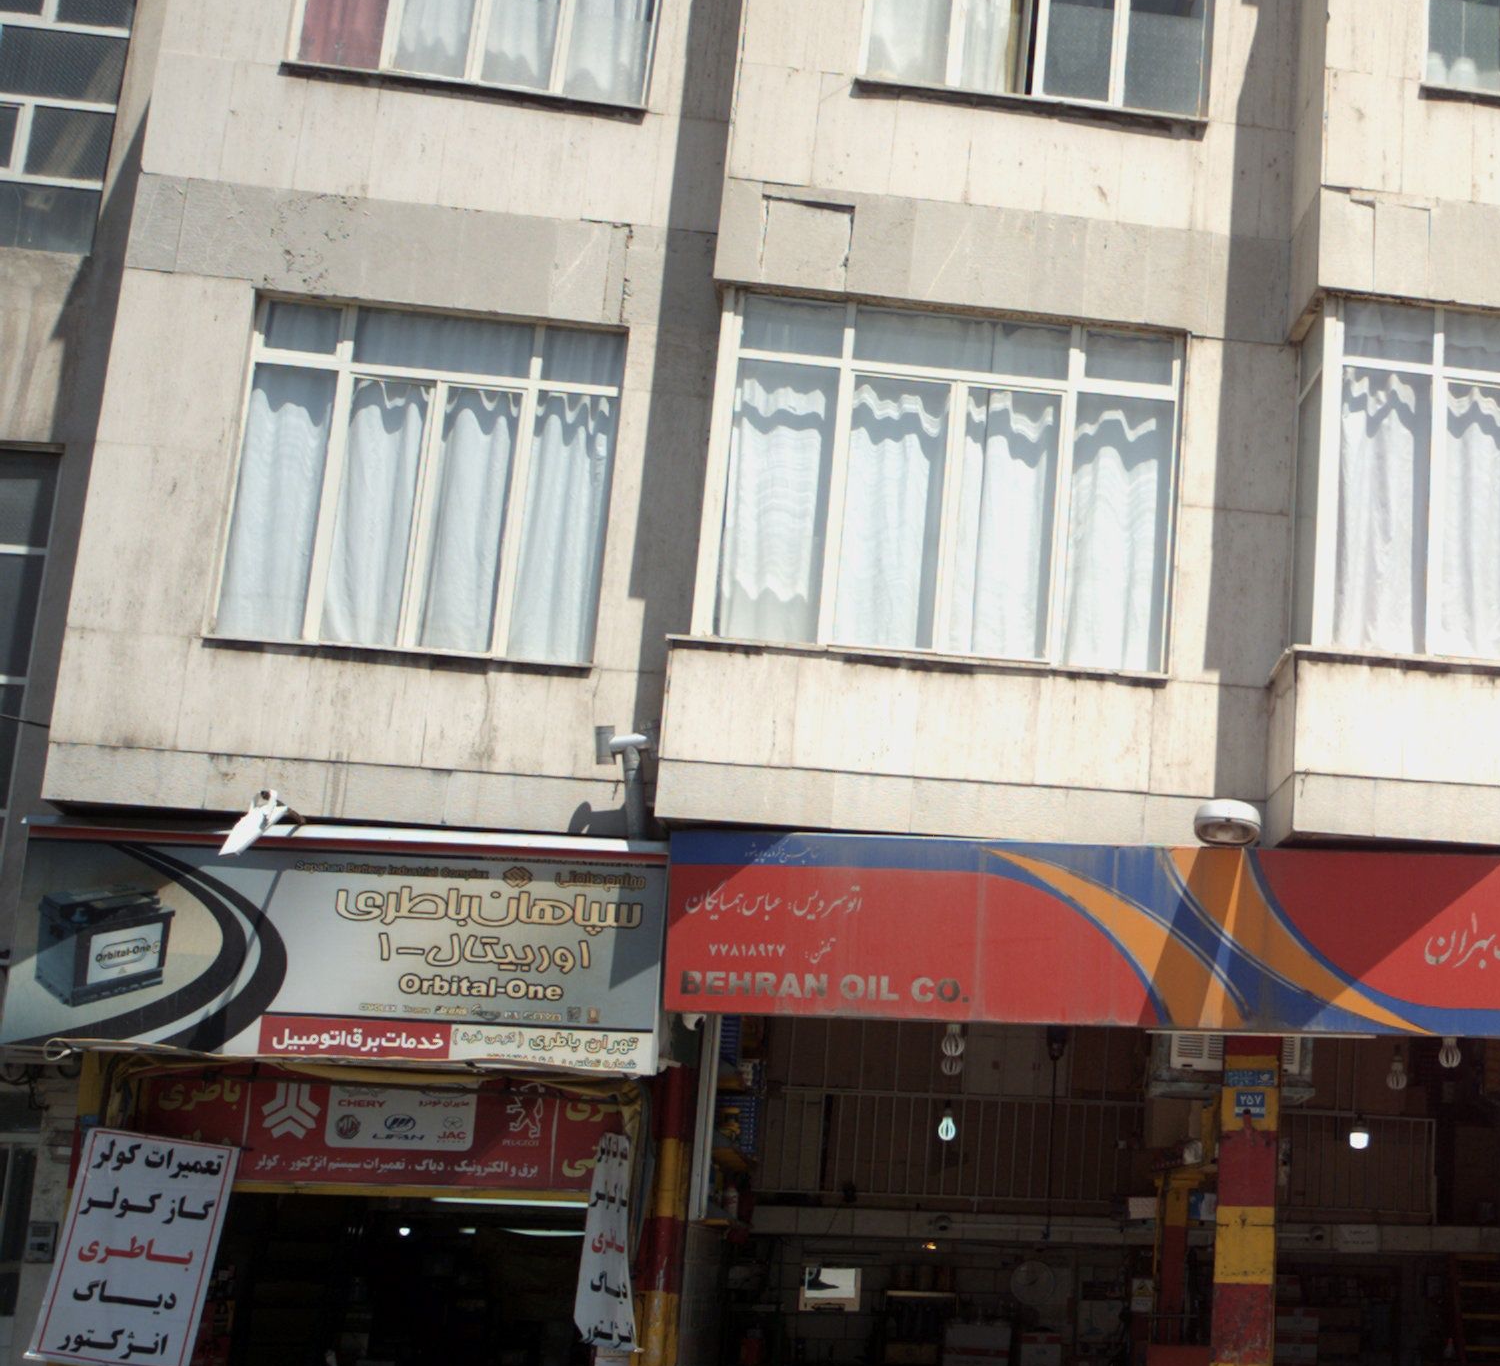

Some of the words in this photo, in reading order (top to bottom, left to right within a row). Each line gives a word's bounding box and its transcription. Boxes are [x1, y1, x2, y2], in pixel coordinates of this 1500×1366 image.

[335, 886, 472, 927] باطری
[469, 891, 643, 936] سپاهان
[1423, 912, 1497, 969] بهران
[398, 973, 563, 1001] Orbital-One
[680, 970, 828, 998] BEHRAN
[840, 973, 899, 1001] OIL
[911, 977, 969, 1003] CO.
[272, 1028, 347, 1051] اتومبیل
[346, 1027, 382, 1052] برق
[381, 1032, 444, 1050] خدمات
[585, 1034, 639, 1054] تهران
[338, 1099, 387, 1108] CHERY
[437, 1131, 467, 1140] JAC
[92, 1139, 141, 1171] کولر
[145, 1147, 224, 1178] تعمیرات
[363, 1157, 406, 1171] تعمیرات
[454, 1161, 508, 1176] الکترونیک
[518, 1164, 539, 1177] برق
[79, 1186, 162, 1218] کولر
[162, 1195, 215, 1224] گاز
[78, 1236, 194, 1272] باطری
[73, 1280, 177, 1315] دیاگ
[56, 1329, 168, 1359] انژکتور
